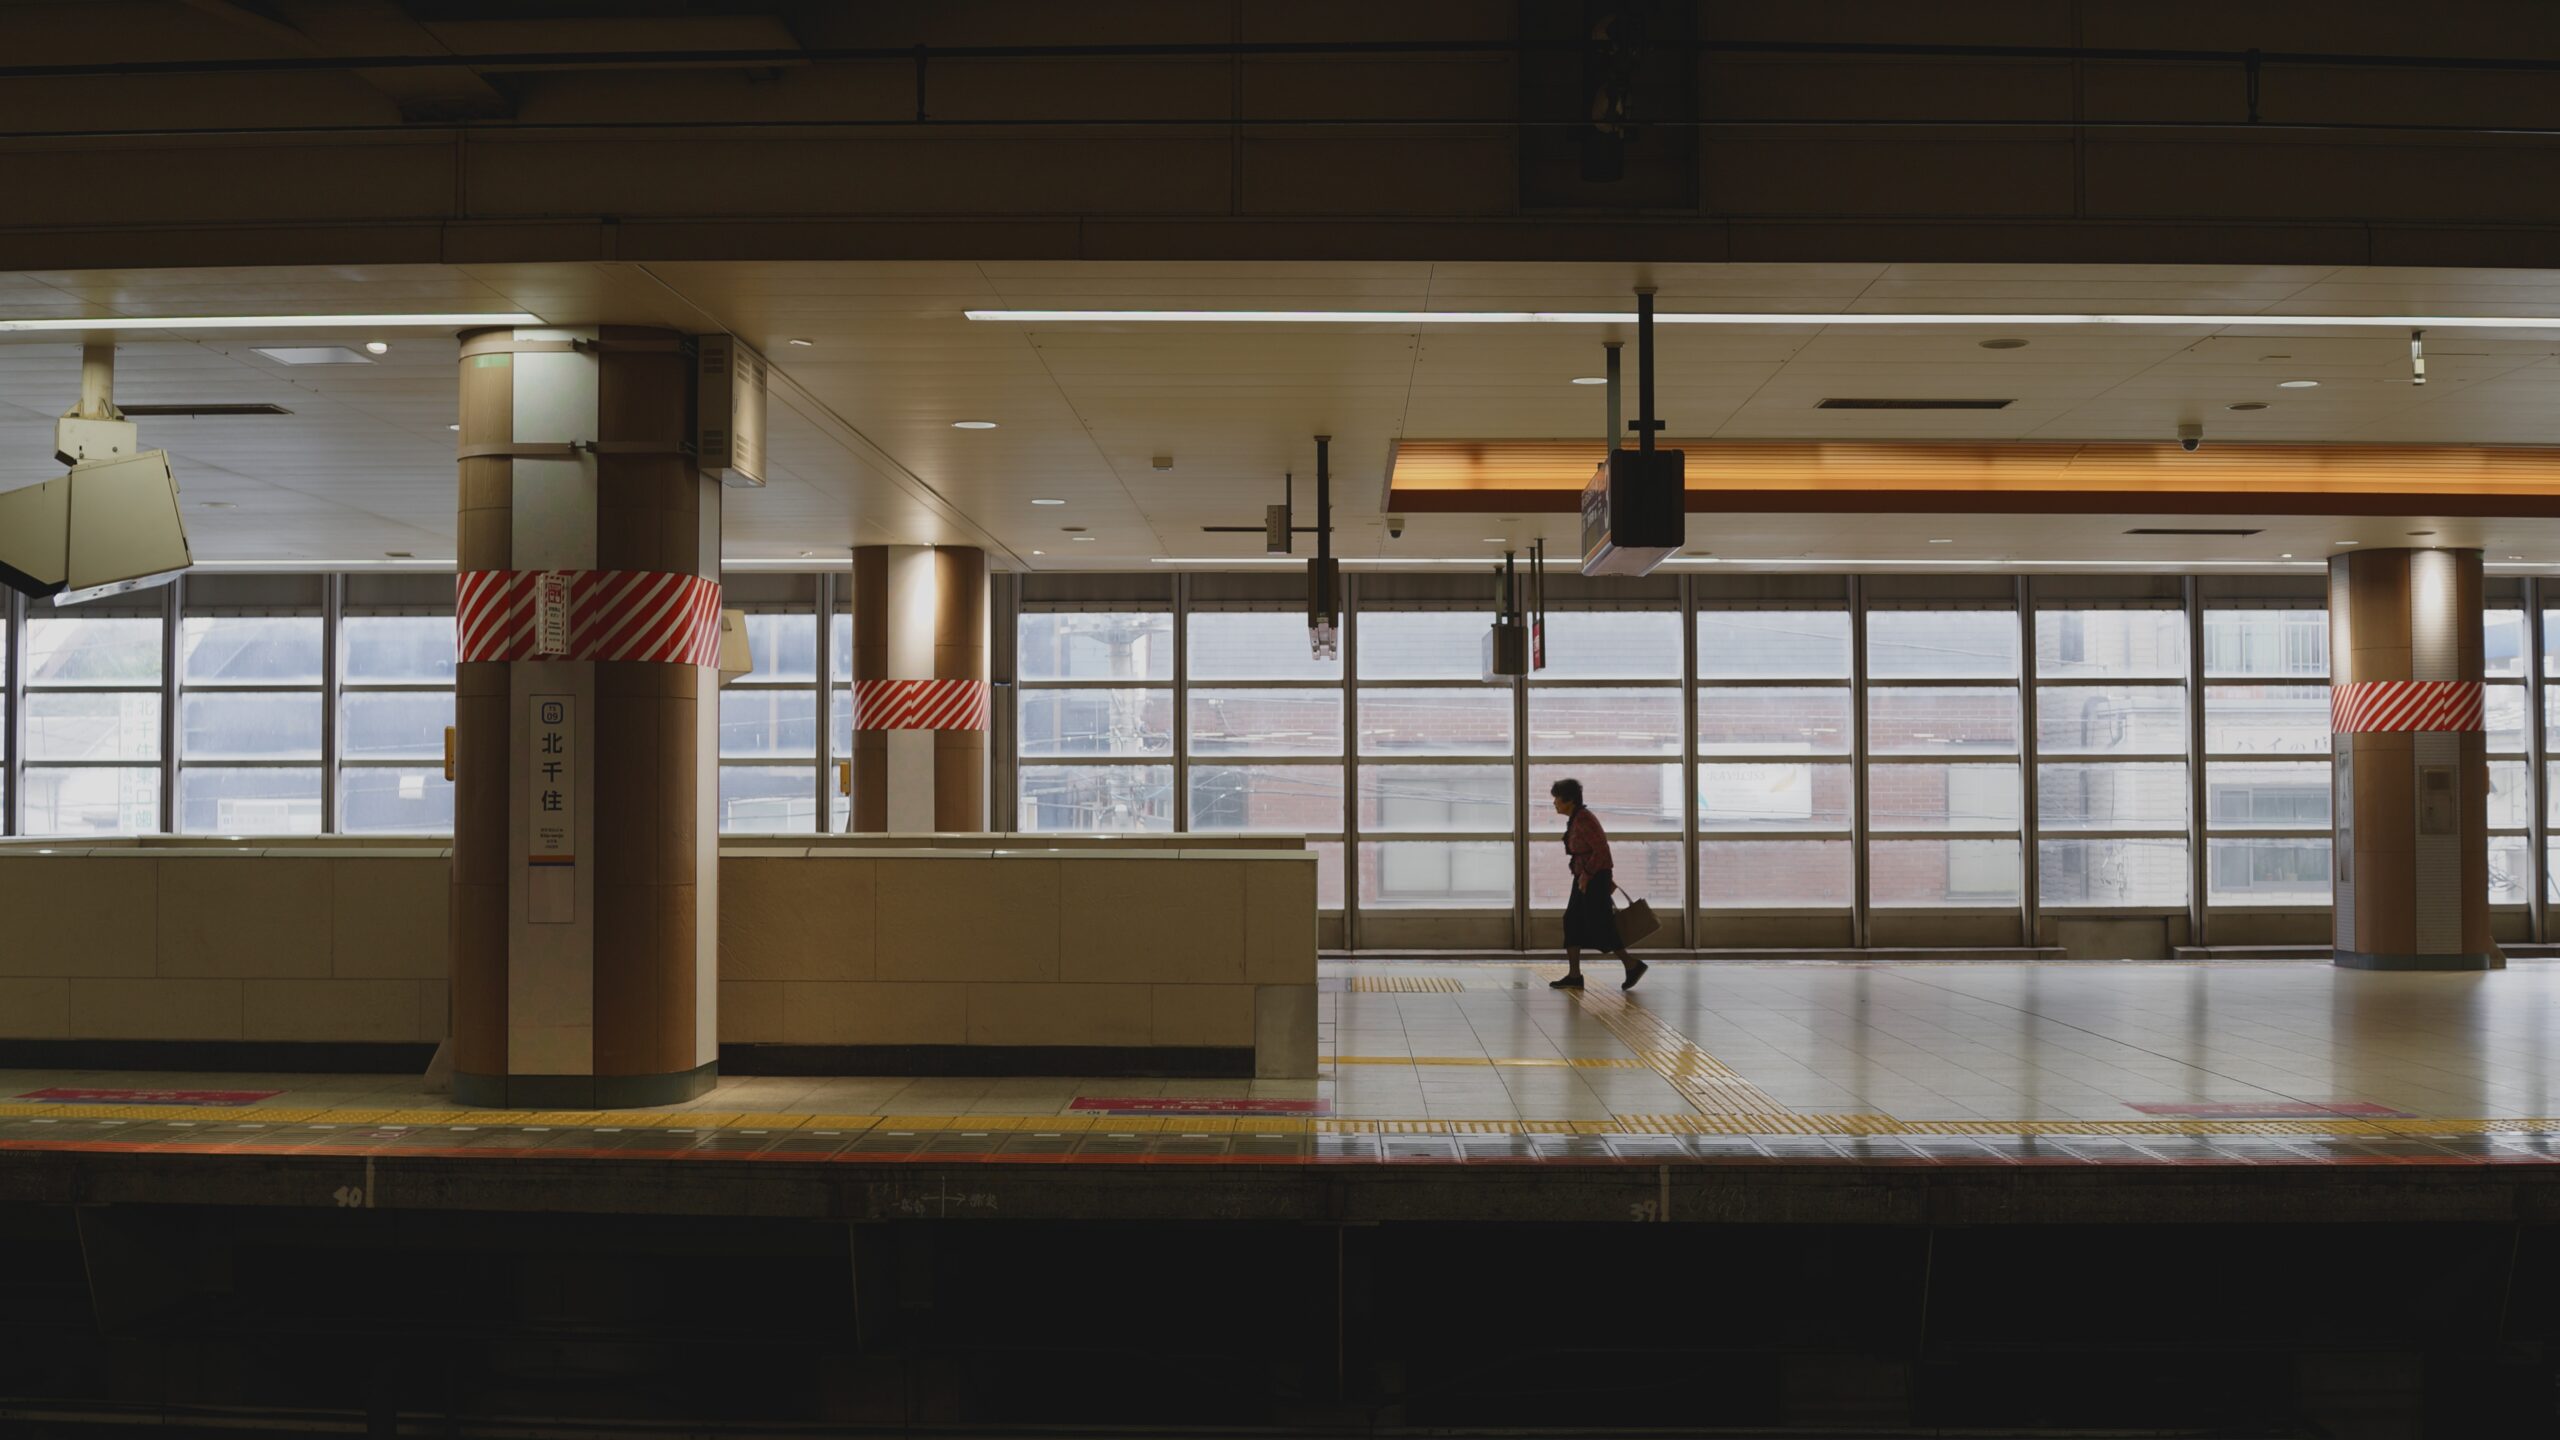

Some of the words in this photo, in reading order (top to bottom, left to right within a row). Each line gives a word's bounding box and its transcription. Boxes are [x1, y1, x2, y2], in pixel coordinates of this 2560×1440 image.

[546, 712, 558, 721] 09
[541, 732, 563, 812] 北千住
[333, 1185, 362, 1208] 40
[1629, 1199, 1657, 1222] 39
